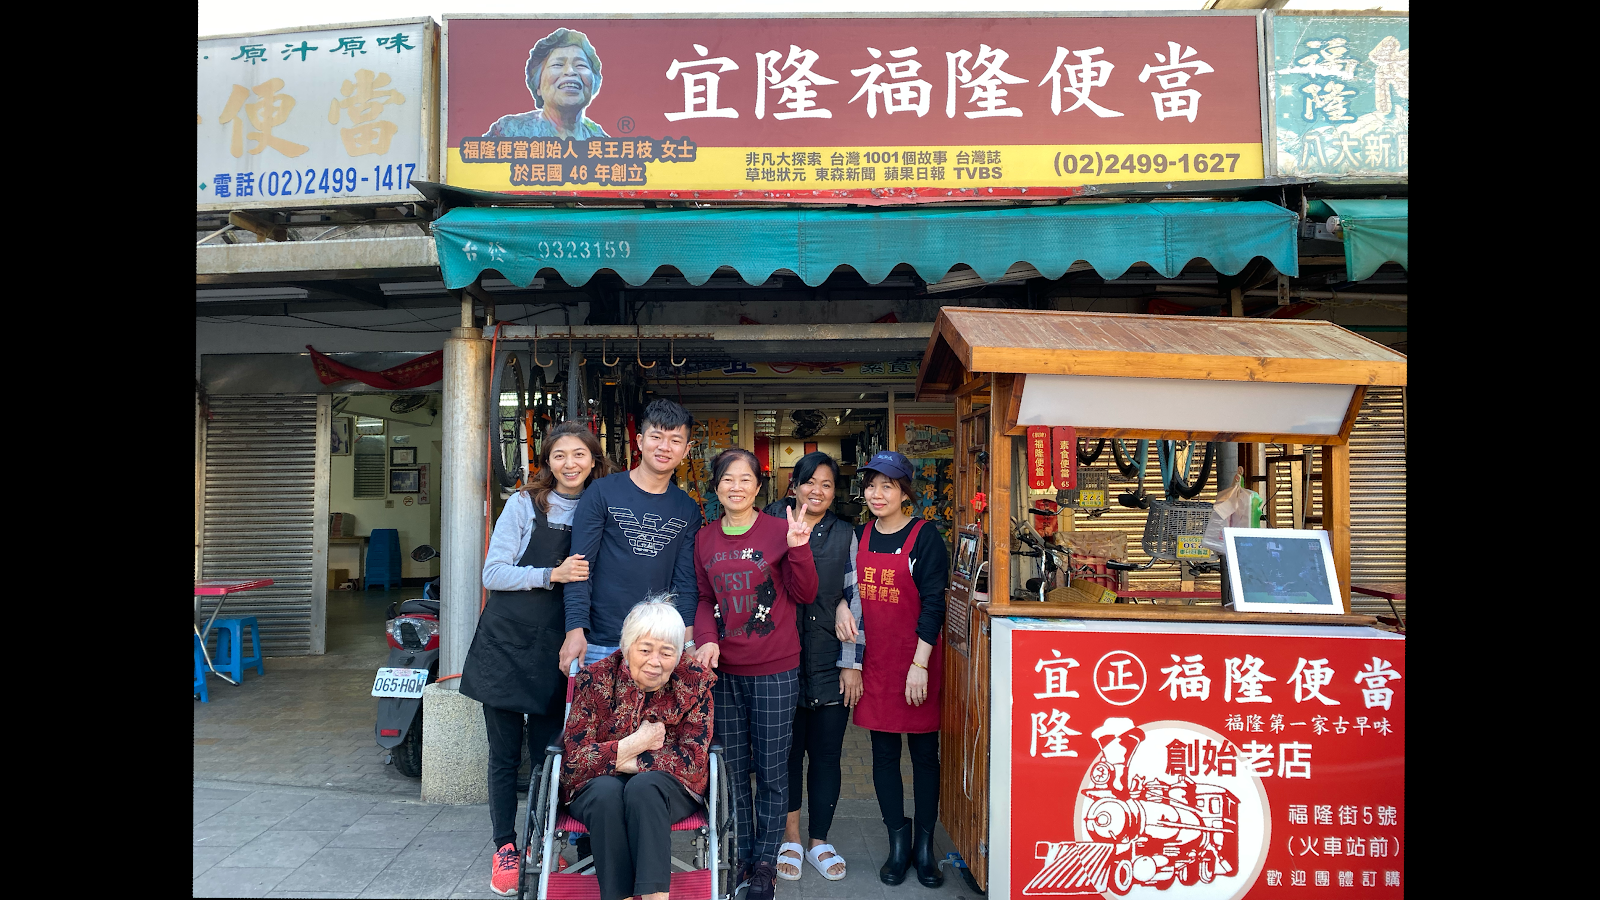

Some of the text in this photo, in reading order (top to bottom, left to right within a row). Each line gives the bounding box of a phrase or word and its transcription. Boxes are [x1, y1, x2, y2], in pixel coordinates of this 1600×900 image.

[230, 33, 416, 65] 原汁原味
[663, 41, 1215, 123] 宜隆福隆便當
[463, 140, 694, 159] 福隆便當創始人 吳王月枝 女士
[745, 151, 822, 167] 非凡大探索
[956, 150, 1002, 165] 台灣誌
[513, 163, 644, 182] 於民國 46 年創立
[745, 166, 1003, 182] 草地狀元 東森新聞 蘋果日報 TVBS
[1053, 151, 1241, 176] (02)2499-1627
[538, 240, 631, 259] 9323159
[1060, 440, 1070, 478] 素食便當
[713, 570, 753, 593] C'EST
[862, 566, 896, 586] 宜隆
[858, 583, 901, 605] 福隆便當
[1225, 713, 1394, 737] 福隆第一家古早味
[1165, 738, 1313, 780] 創始老店
[1288, 804, 1398, 826] 福隆街5號
[1266, 869, 1401, 888] 歡迎團體訂購
